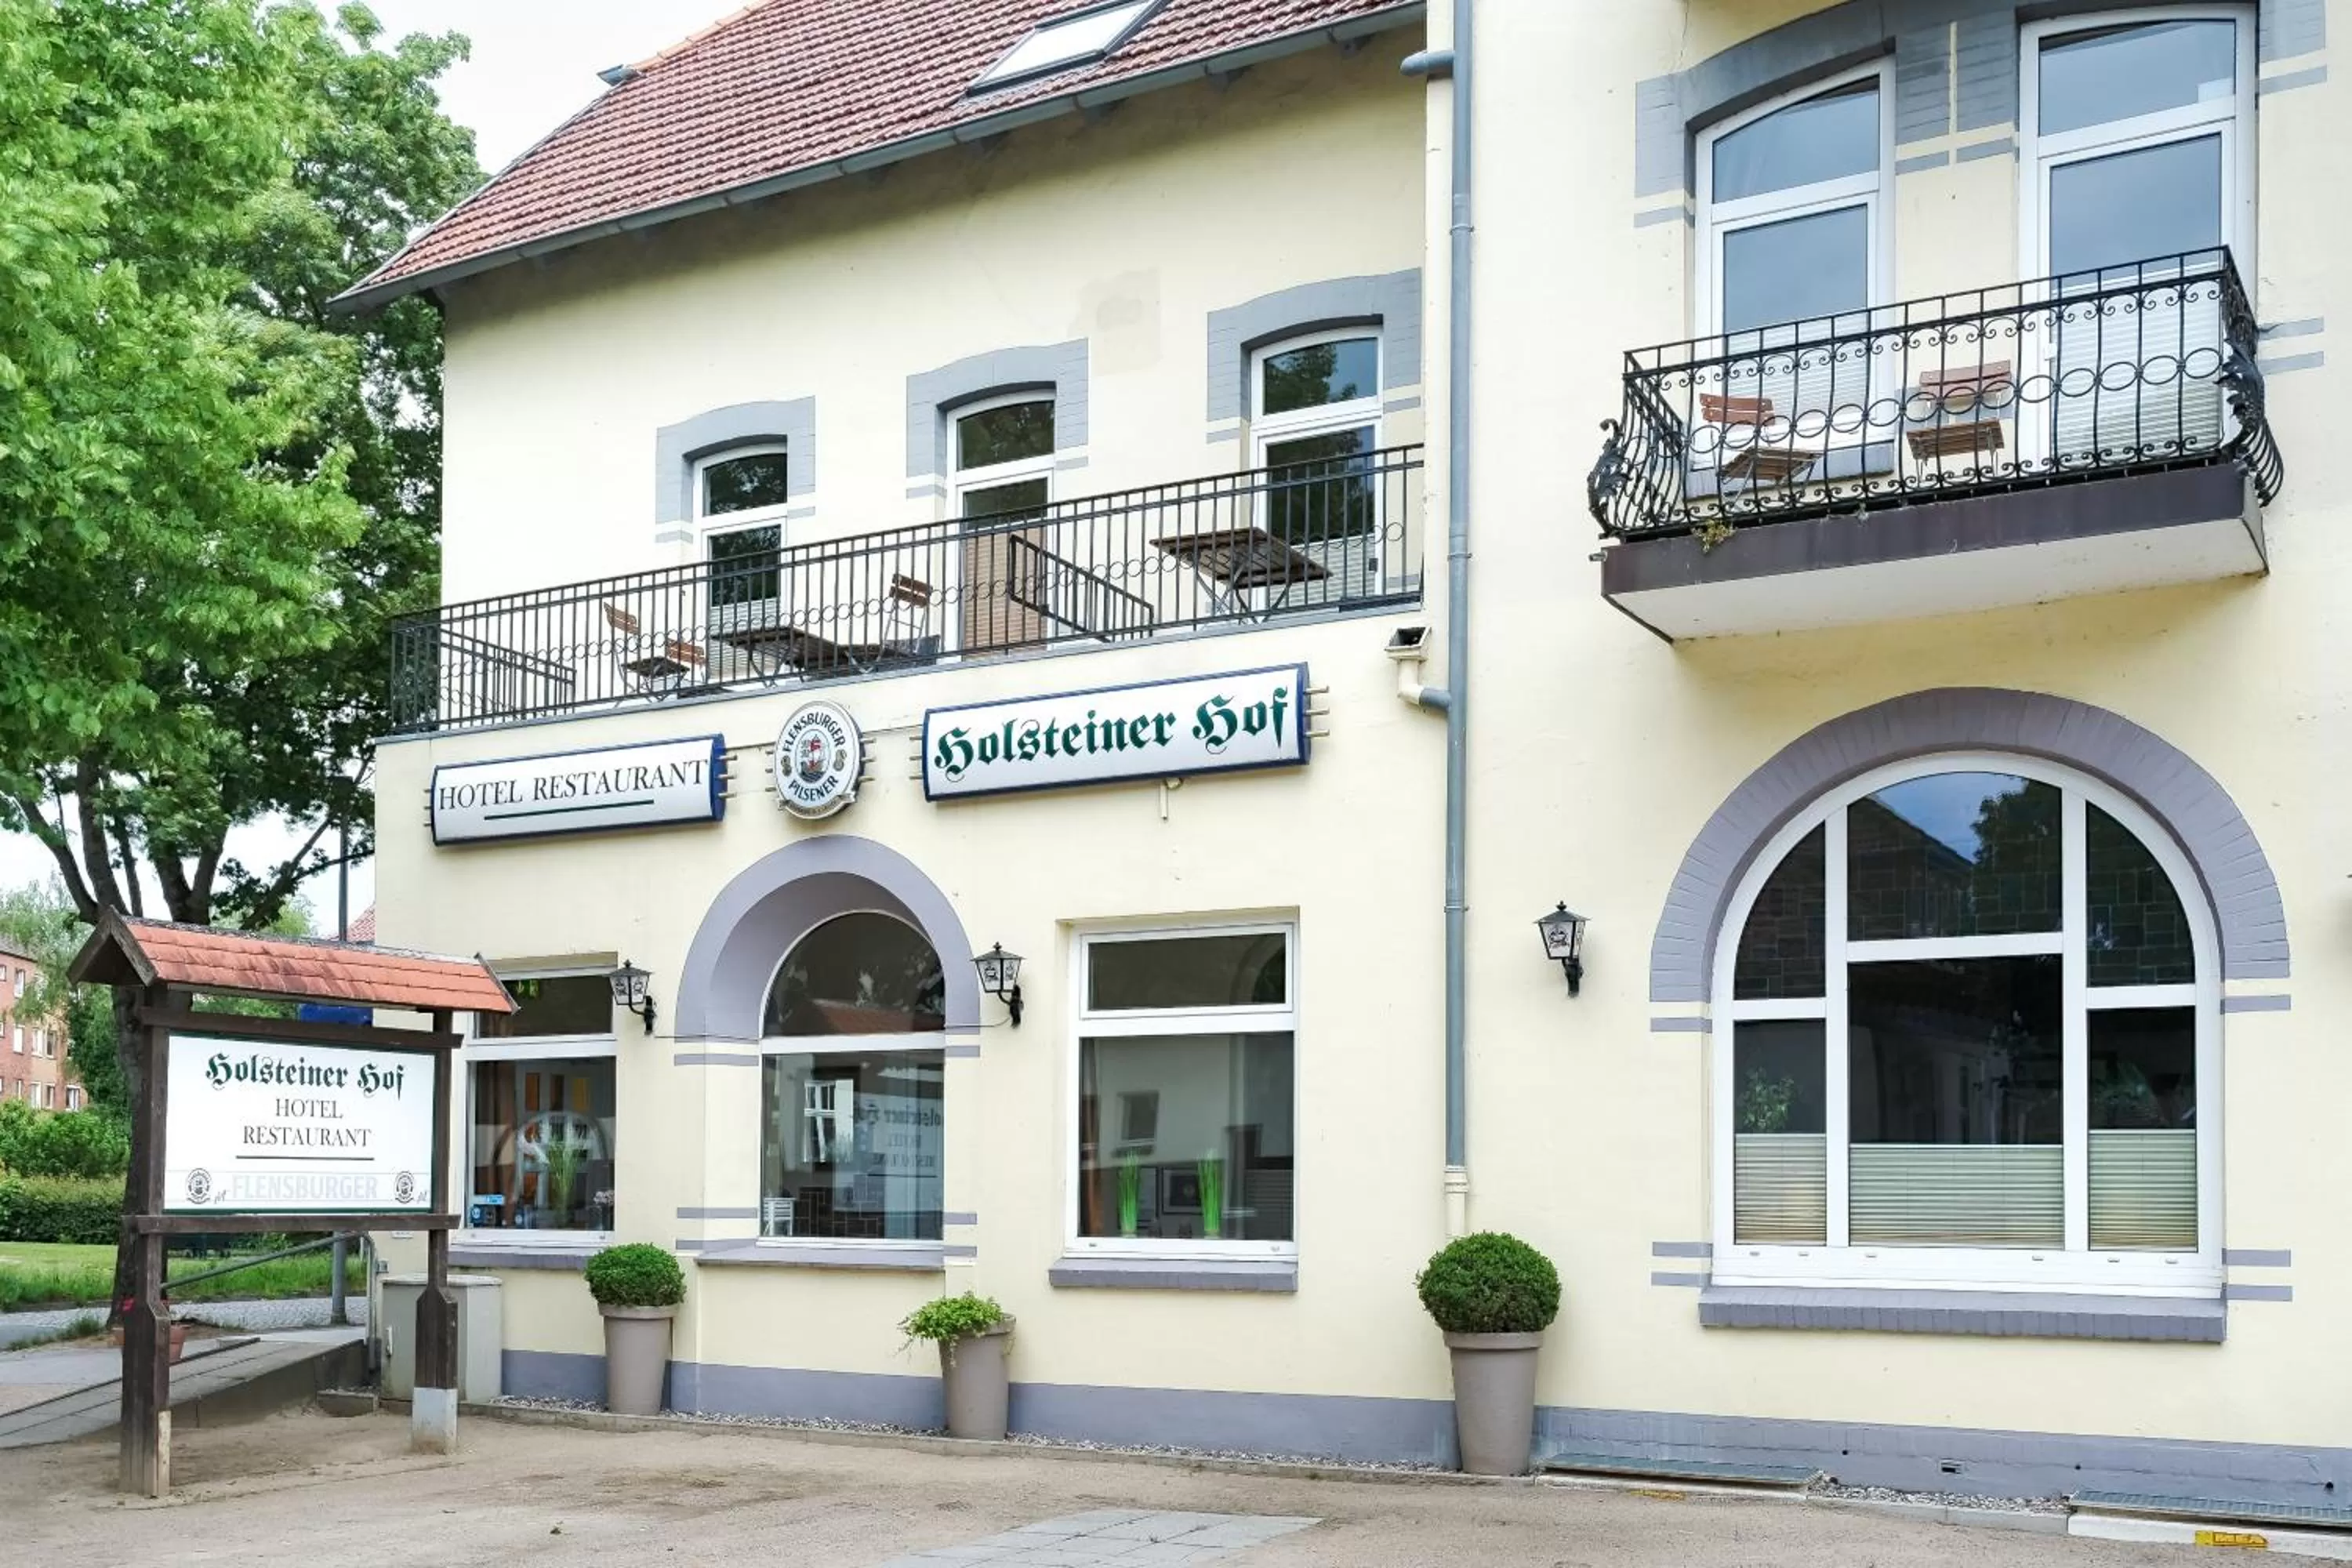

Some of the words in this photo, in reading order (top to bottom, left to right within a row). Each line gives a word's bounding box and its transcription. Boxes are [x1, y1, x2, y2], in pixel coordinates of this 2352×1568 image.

[782, 712, 846, 752] FLENSBURGER
[934, 710, 1177, 782] Holsteiner
[1192, 685, 1288, 759] Hof
[438, 779, 523, 811] HOTEL
[534, 758, 709, 802] RESTAURANT
[788, 775, 839, 802] PILSENER
[205, 1052, 349, 1091] Holsteiner
[357, 1062, 405, 1100] Hof
[275, 1098, 343, 1119] HOTEL
[243, 1125, 372, 1147] RESTAURANT
[232, 1175, 378, 1200] FLENSBURGER
